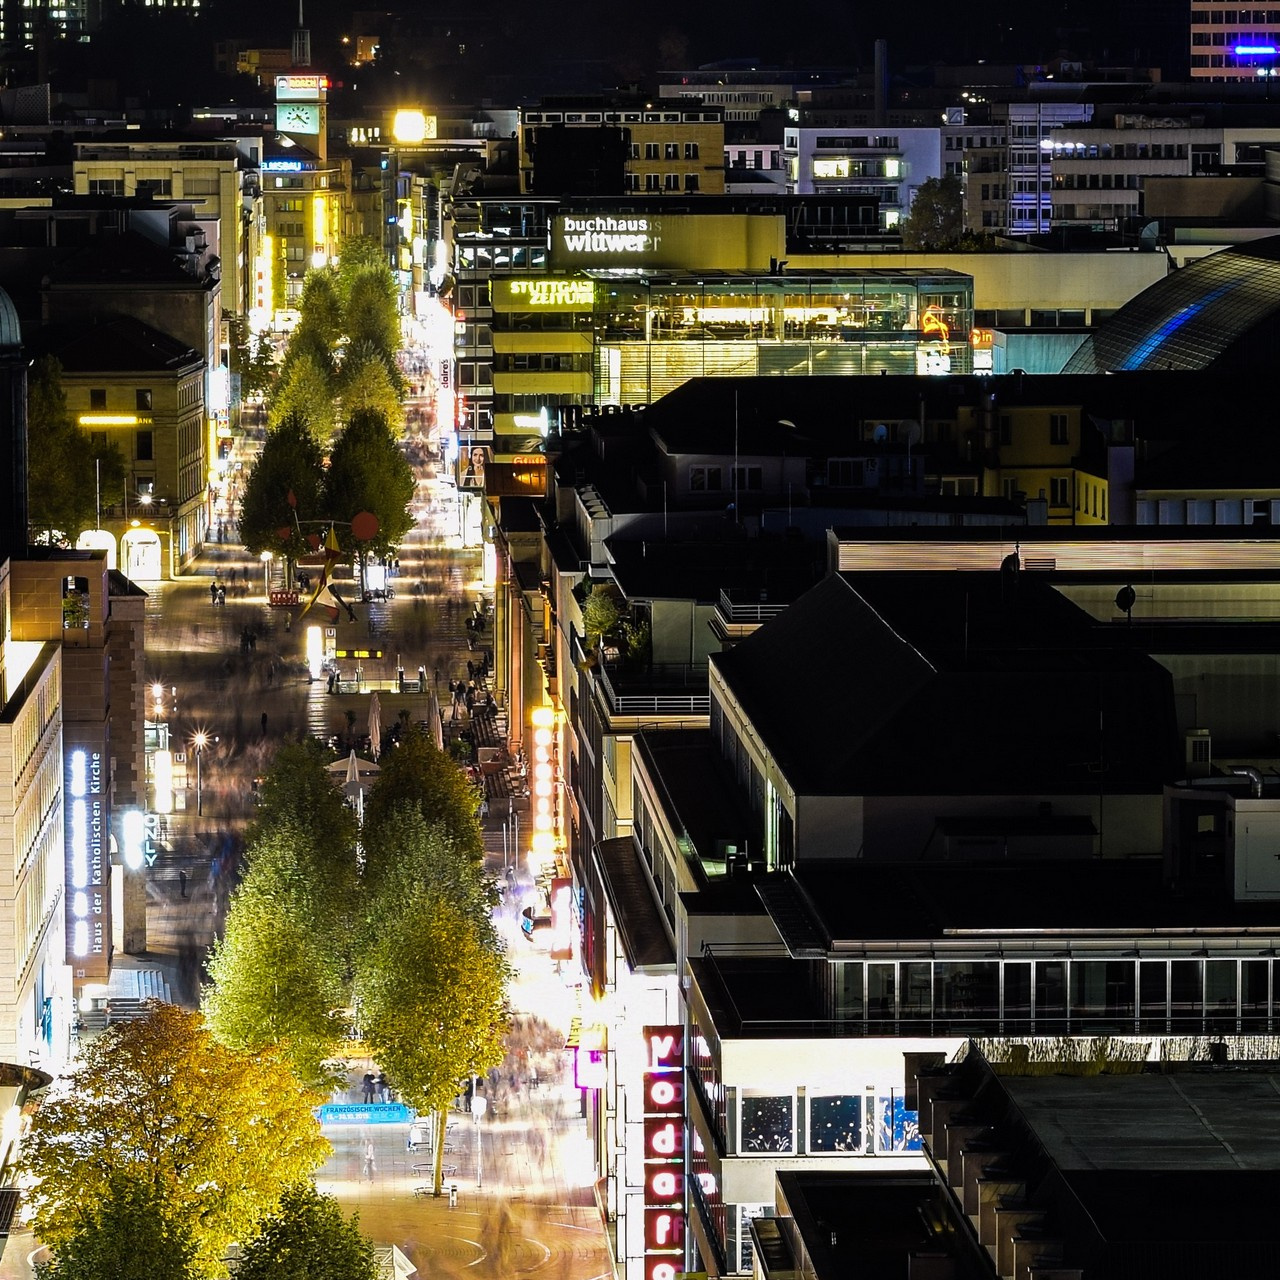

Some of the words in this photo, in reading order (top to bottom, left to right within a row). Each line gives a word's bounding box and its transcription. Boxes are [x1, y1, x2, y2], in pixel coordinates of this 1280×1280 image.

[563, 216, 648, 232] buchhaus
[563, 231, 648, 252] wittwer
[90, 752, 101, 794] Kirche
[90, 801, 102, 885] Katholischen
[144, 814, 158, 867] ONLY
[92, 892, 102, 914] der
[92, 922, 102, 953] Haus
